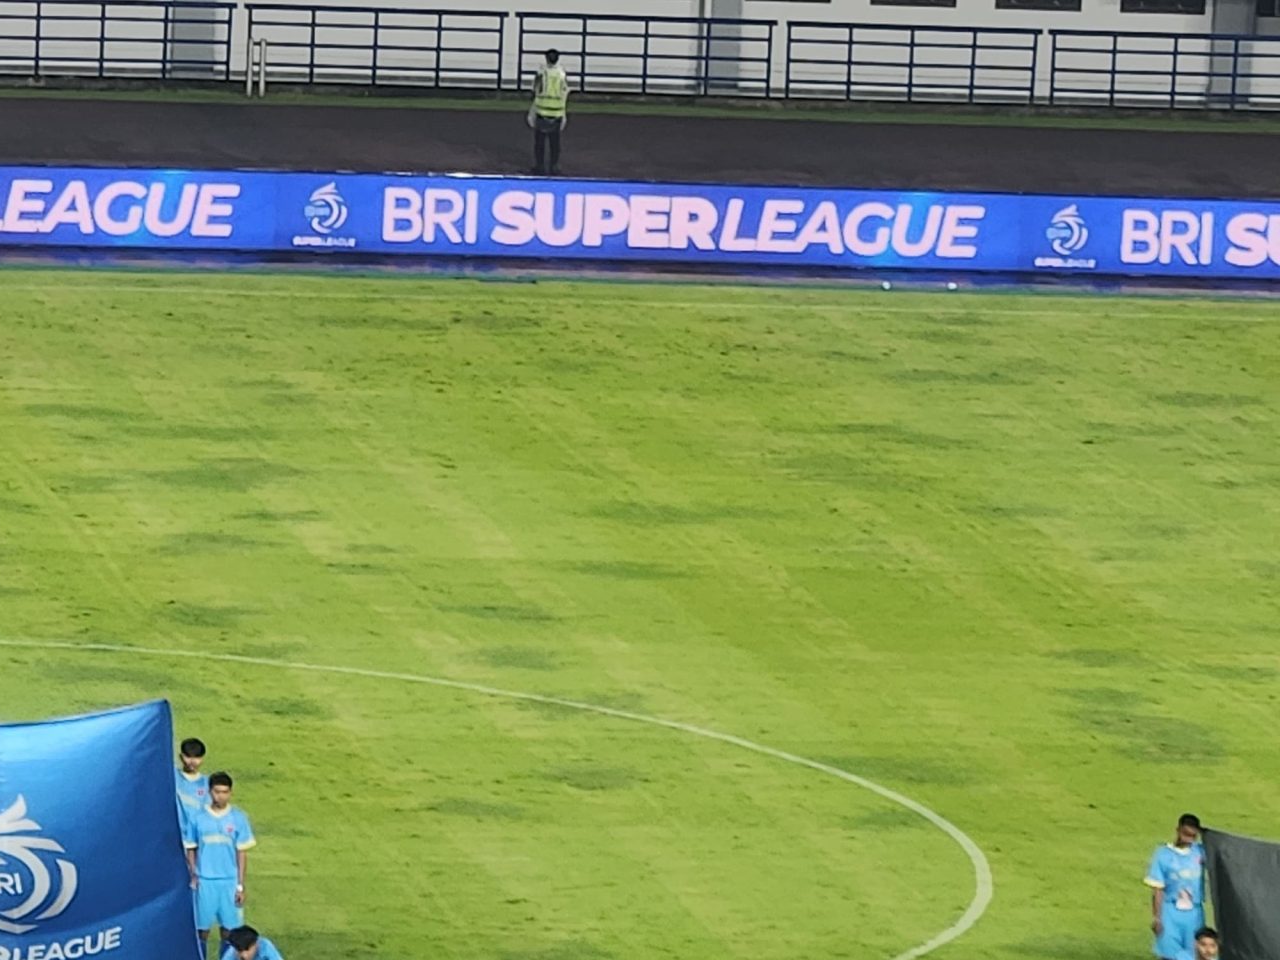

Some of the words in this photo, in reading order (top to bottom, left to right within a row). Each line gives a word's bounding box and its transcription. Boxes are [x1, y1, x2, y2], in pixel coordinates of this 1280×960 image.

[382, 186, 479, 245] BRI
[1120, 209, 1215, 266] BRI
[1224, 212, 1280, 267] S
